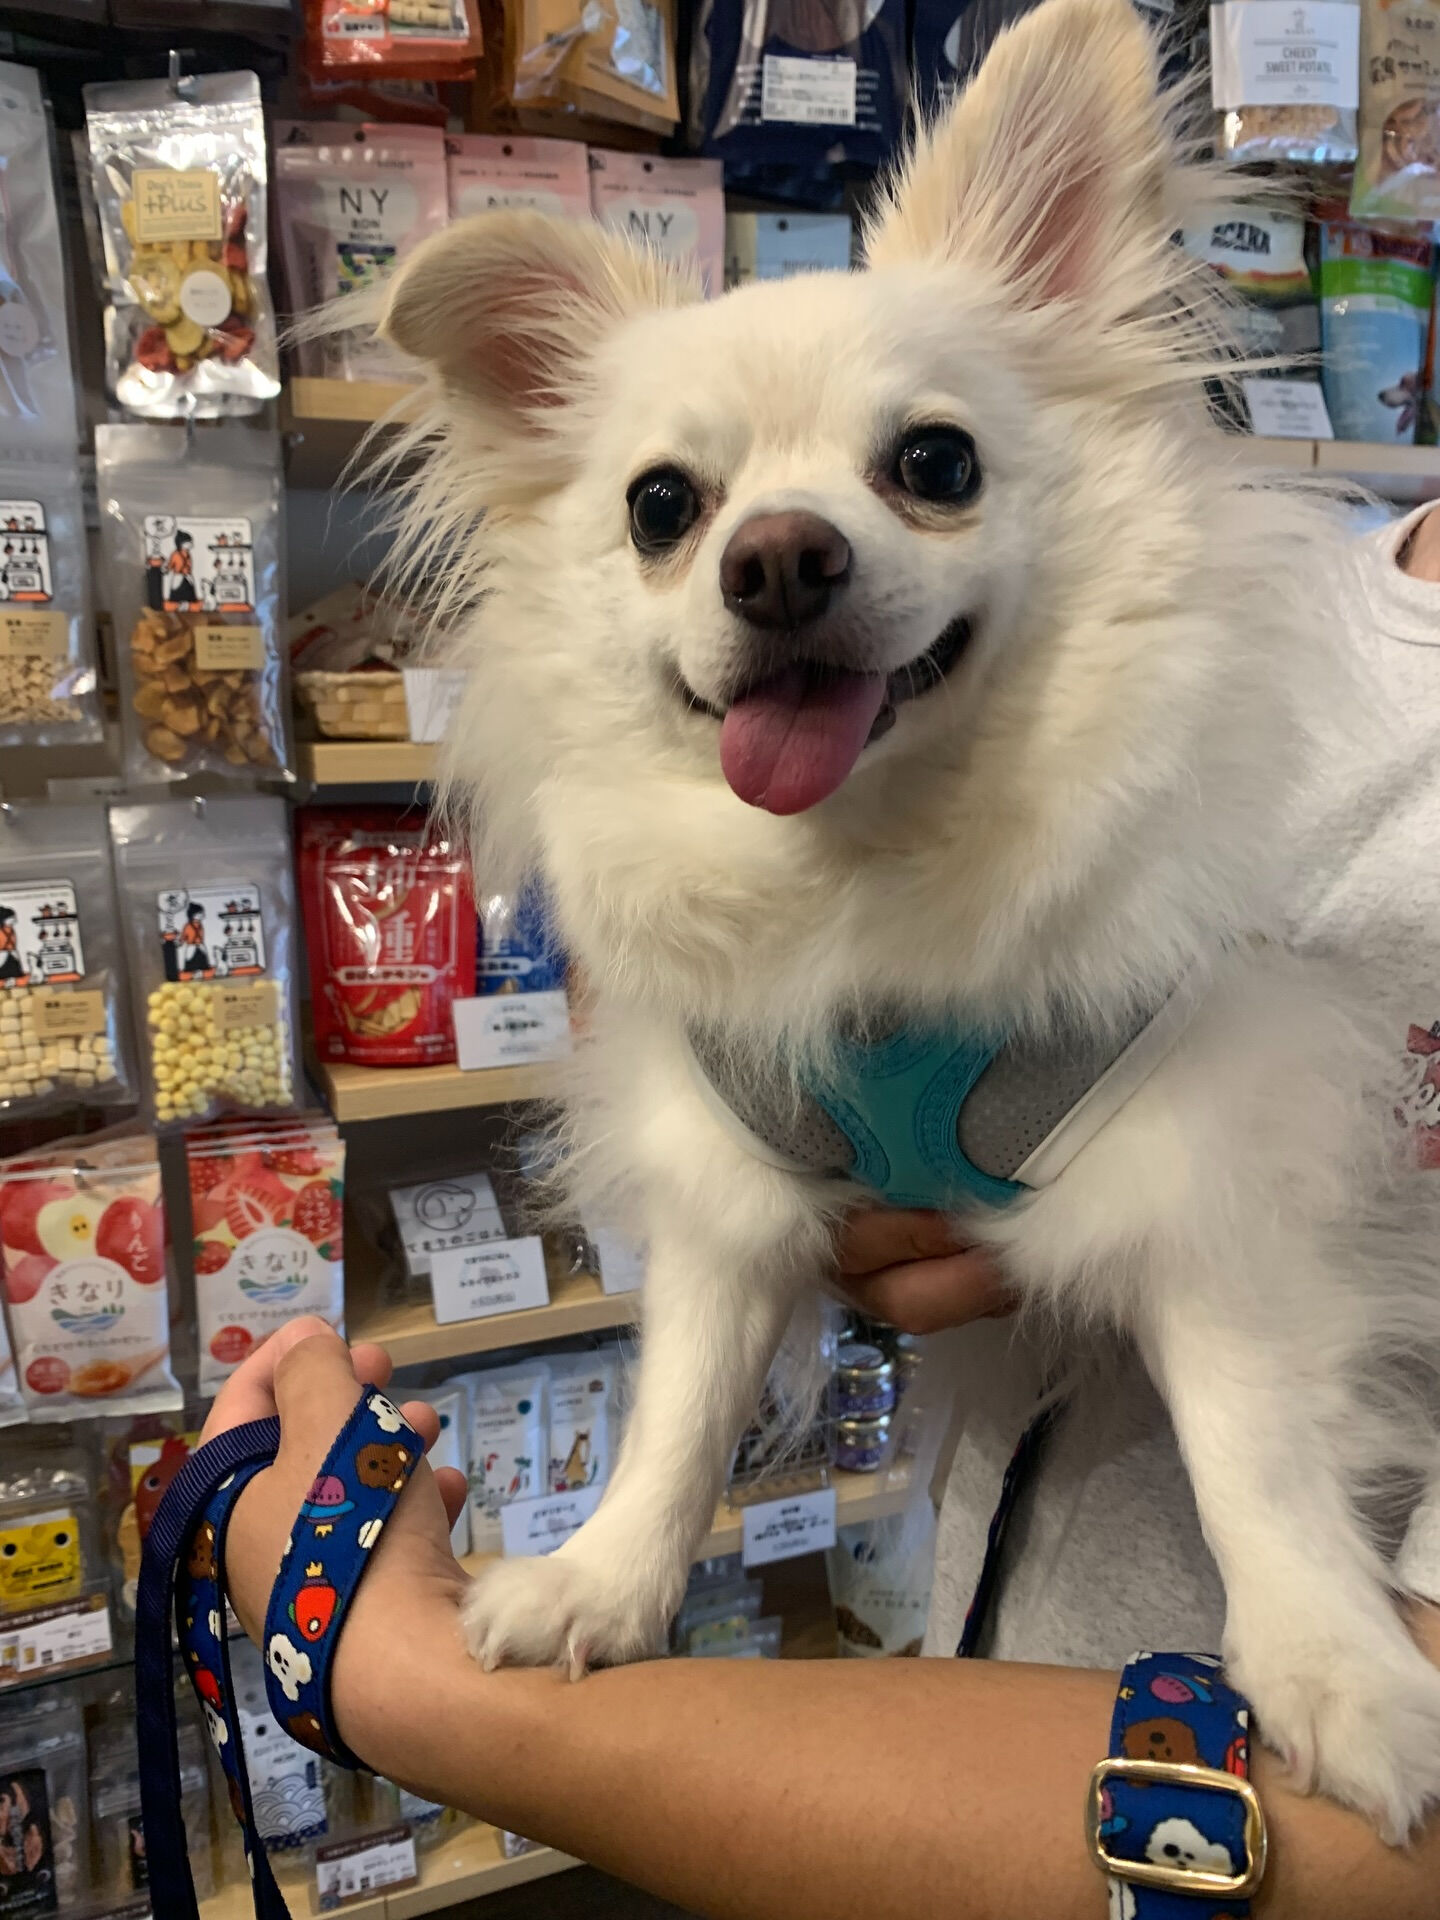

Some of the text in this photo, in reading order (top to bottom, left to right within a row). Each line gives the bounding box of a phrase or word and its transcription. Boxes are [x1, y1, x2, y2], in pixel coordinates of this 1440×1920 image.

[339, 187, 389, 214] NY
[239, 1249, 308, 1276] きなり
[50, 1278, 124, 1306] きなり
